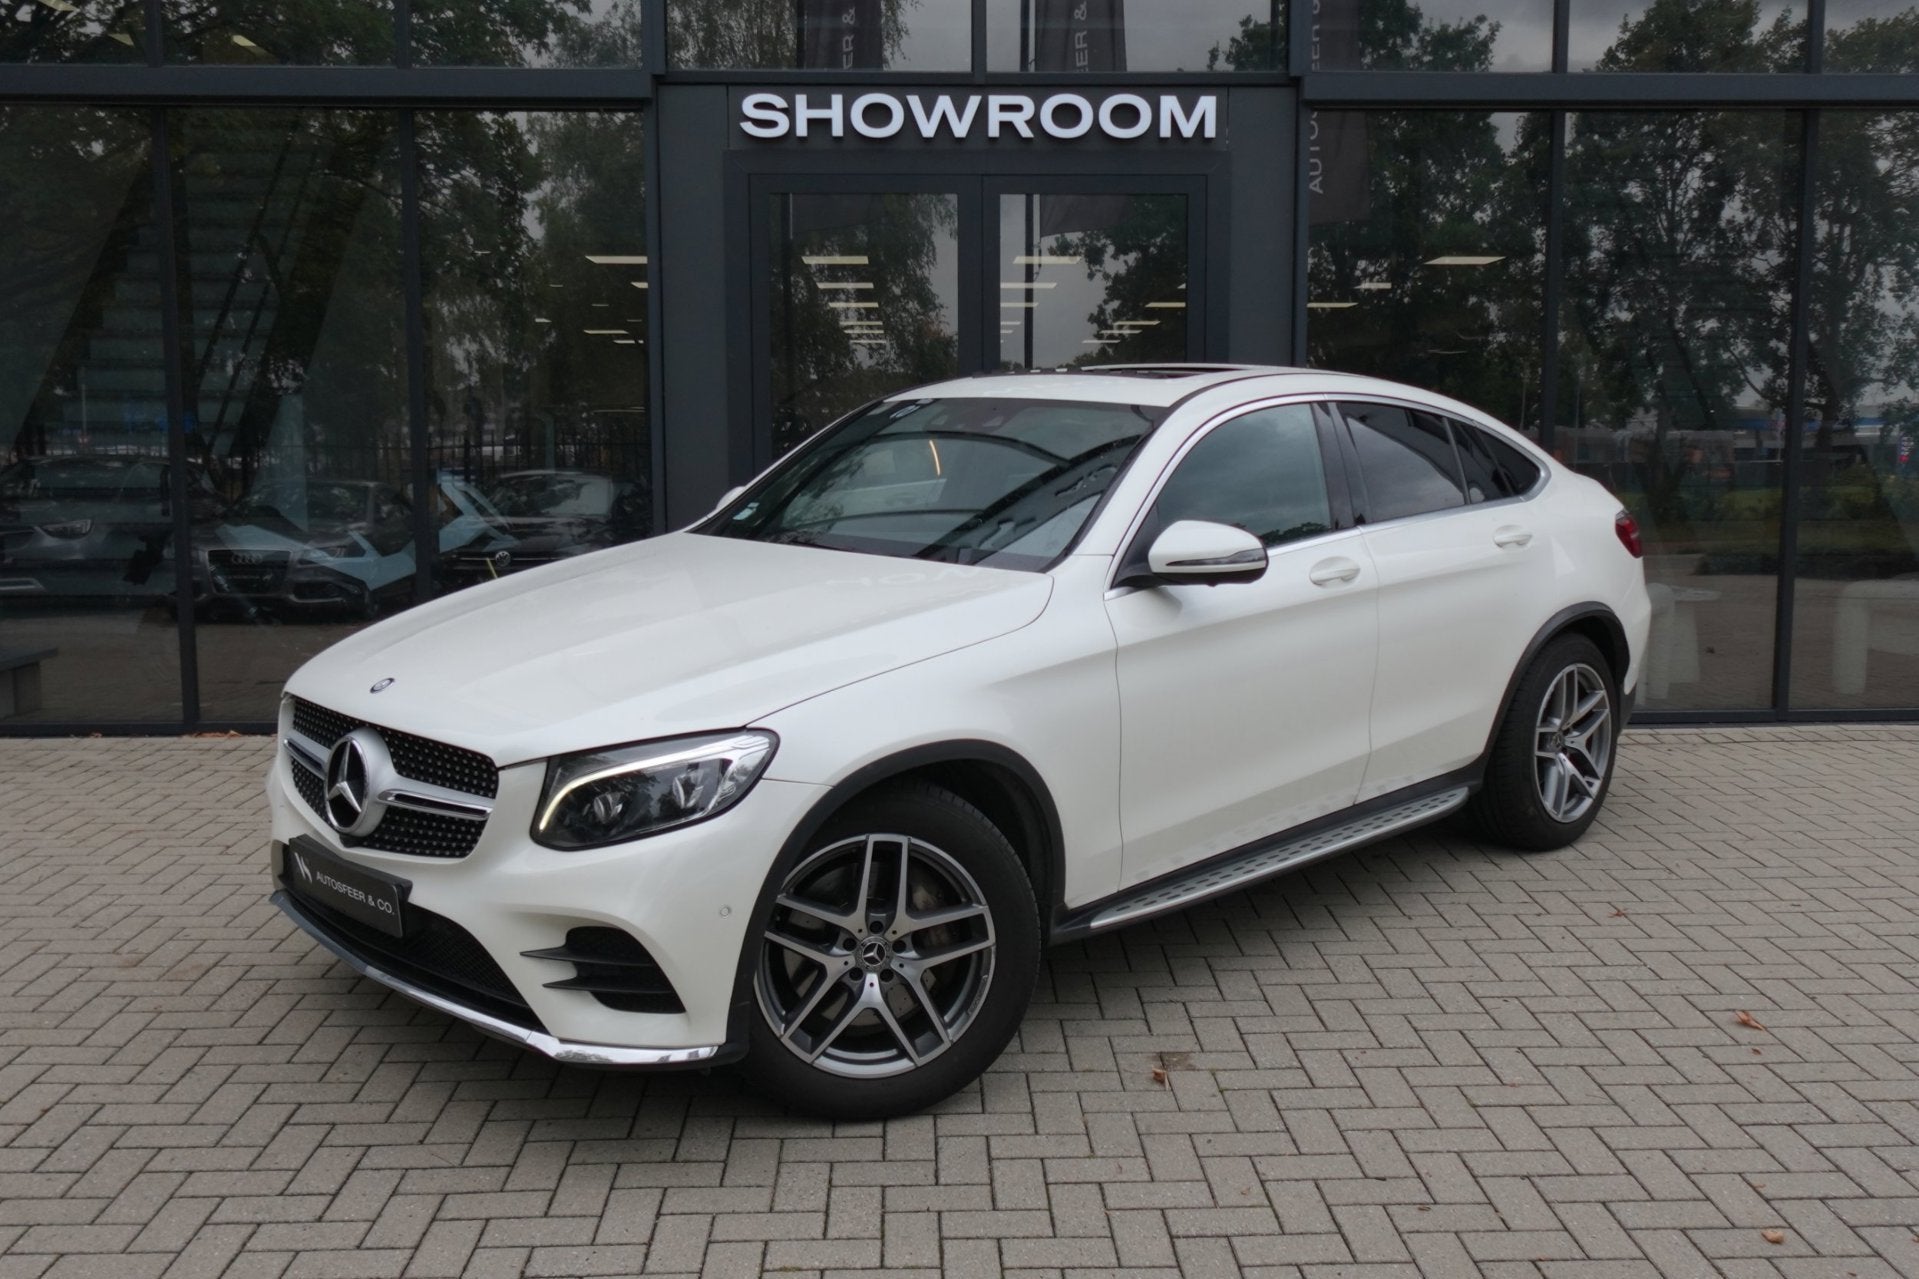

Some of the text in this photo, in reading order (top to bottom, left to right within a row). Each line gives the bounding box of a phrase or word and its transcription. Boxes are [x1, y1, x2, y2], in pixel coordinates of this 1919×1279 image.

[739, 92, 1217, 140] SHOWROOM
[367, 894, 376, 907] &
[377, 898, 395, 915] CO.
